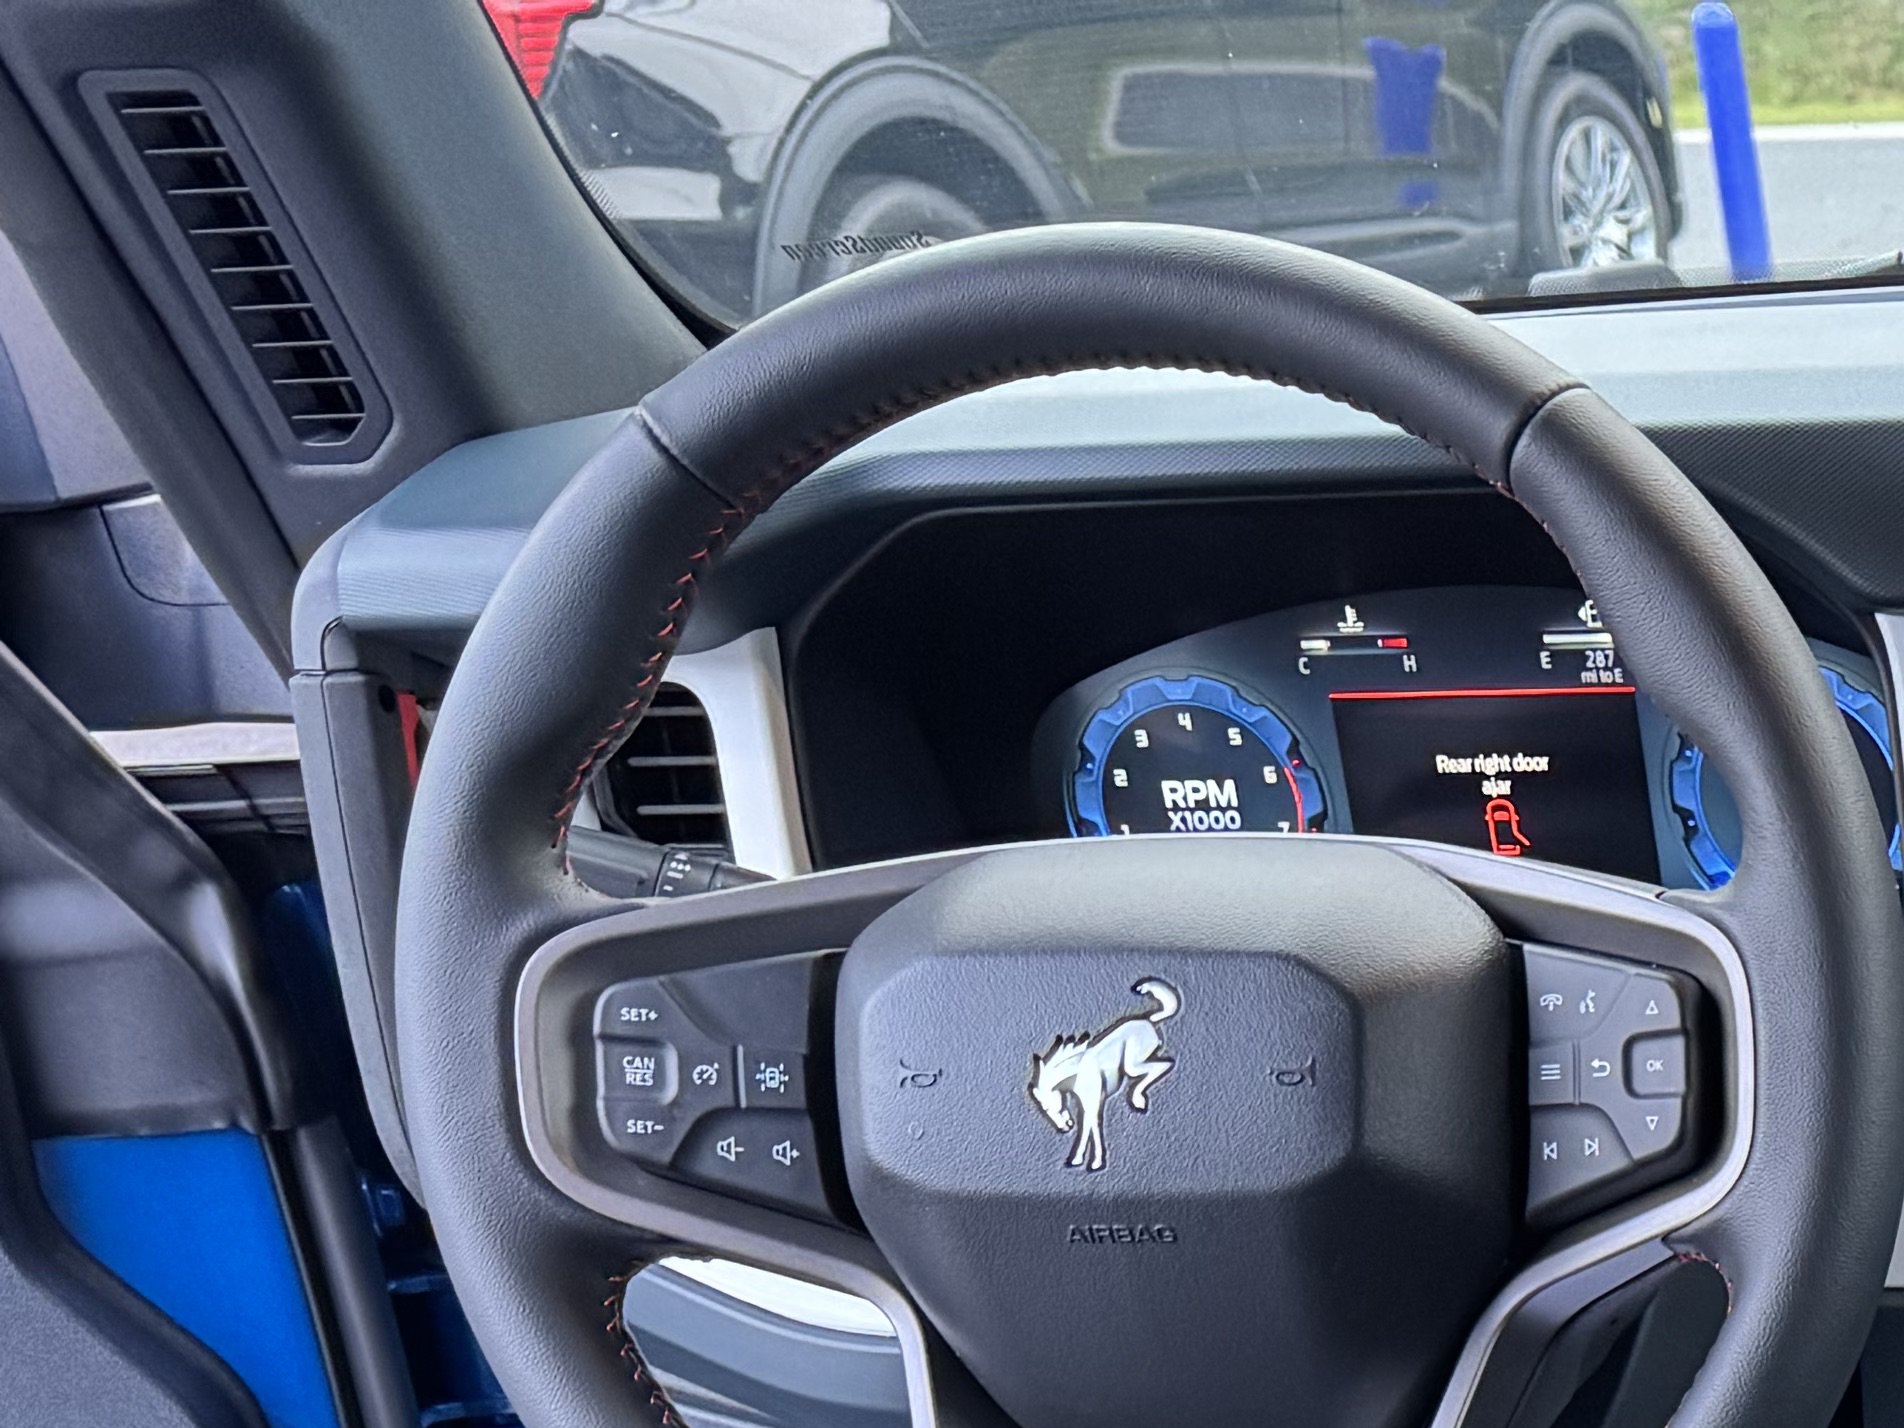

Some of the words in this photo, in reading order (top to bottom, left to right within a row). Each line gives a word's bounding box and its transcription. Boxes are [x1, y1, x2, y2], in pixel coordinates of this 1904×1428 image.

[1298, 657, 1311, 675] C
[1403, 654, 1417, 672] H
[1540, 651, 1552, 669] E
[1585, 650, 1614, 668] 287
[1581, 670, 1598, 684] mi
[1599, 670, 1613, 684] to
[1614, 669, 1624, 683] E
[1177, 712, 1193, 731] 4
[1134, 729, 1149, 748] 3
[1227, 727, 1242, 746] 5
[1435, 755, 1473, 774] Rear
[1474, 753, 1511, 776] right
[1512, 752, 1549, 772] door
[1113, 768, 1128, 787] 2
[1263, 766, 1277, 784] 6
[1161, 779, 1239, 809] RPM
[1482, 778, 1512, 798] ajar
[1167, 810, 1242, 832] X1000
[622, 1056, 655, 1071] CAN
[1646, 1059, 1664, 1071] OK
[626, 1073, 654, 1086] RES
[1066, 1224, 1178, 1244] AIRBAG
